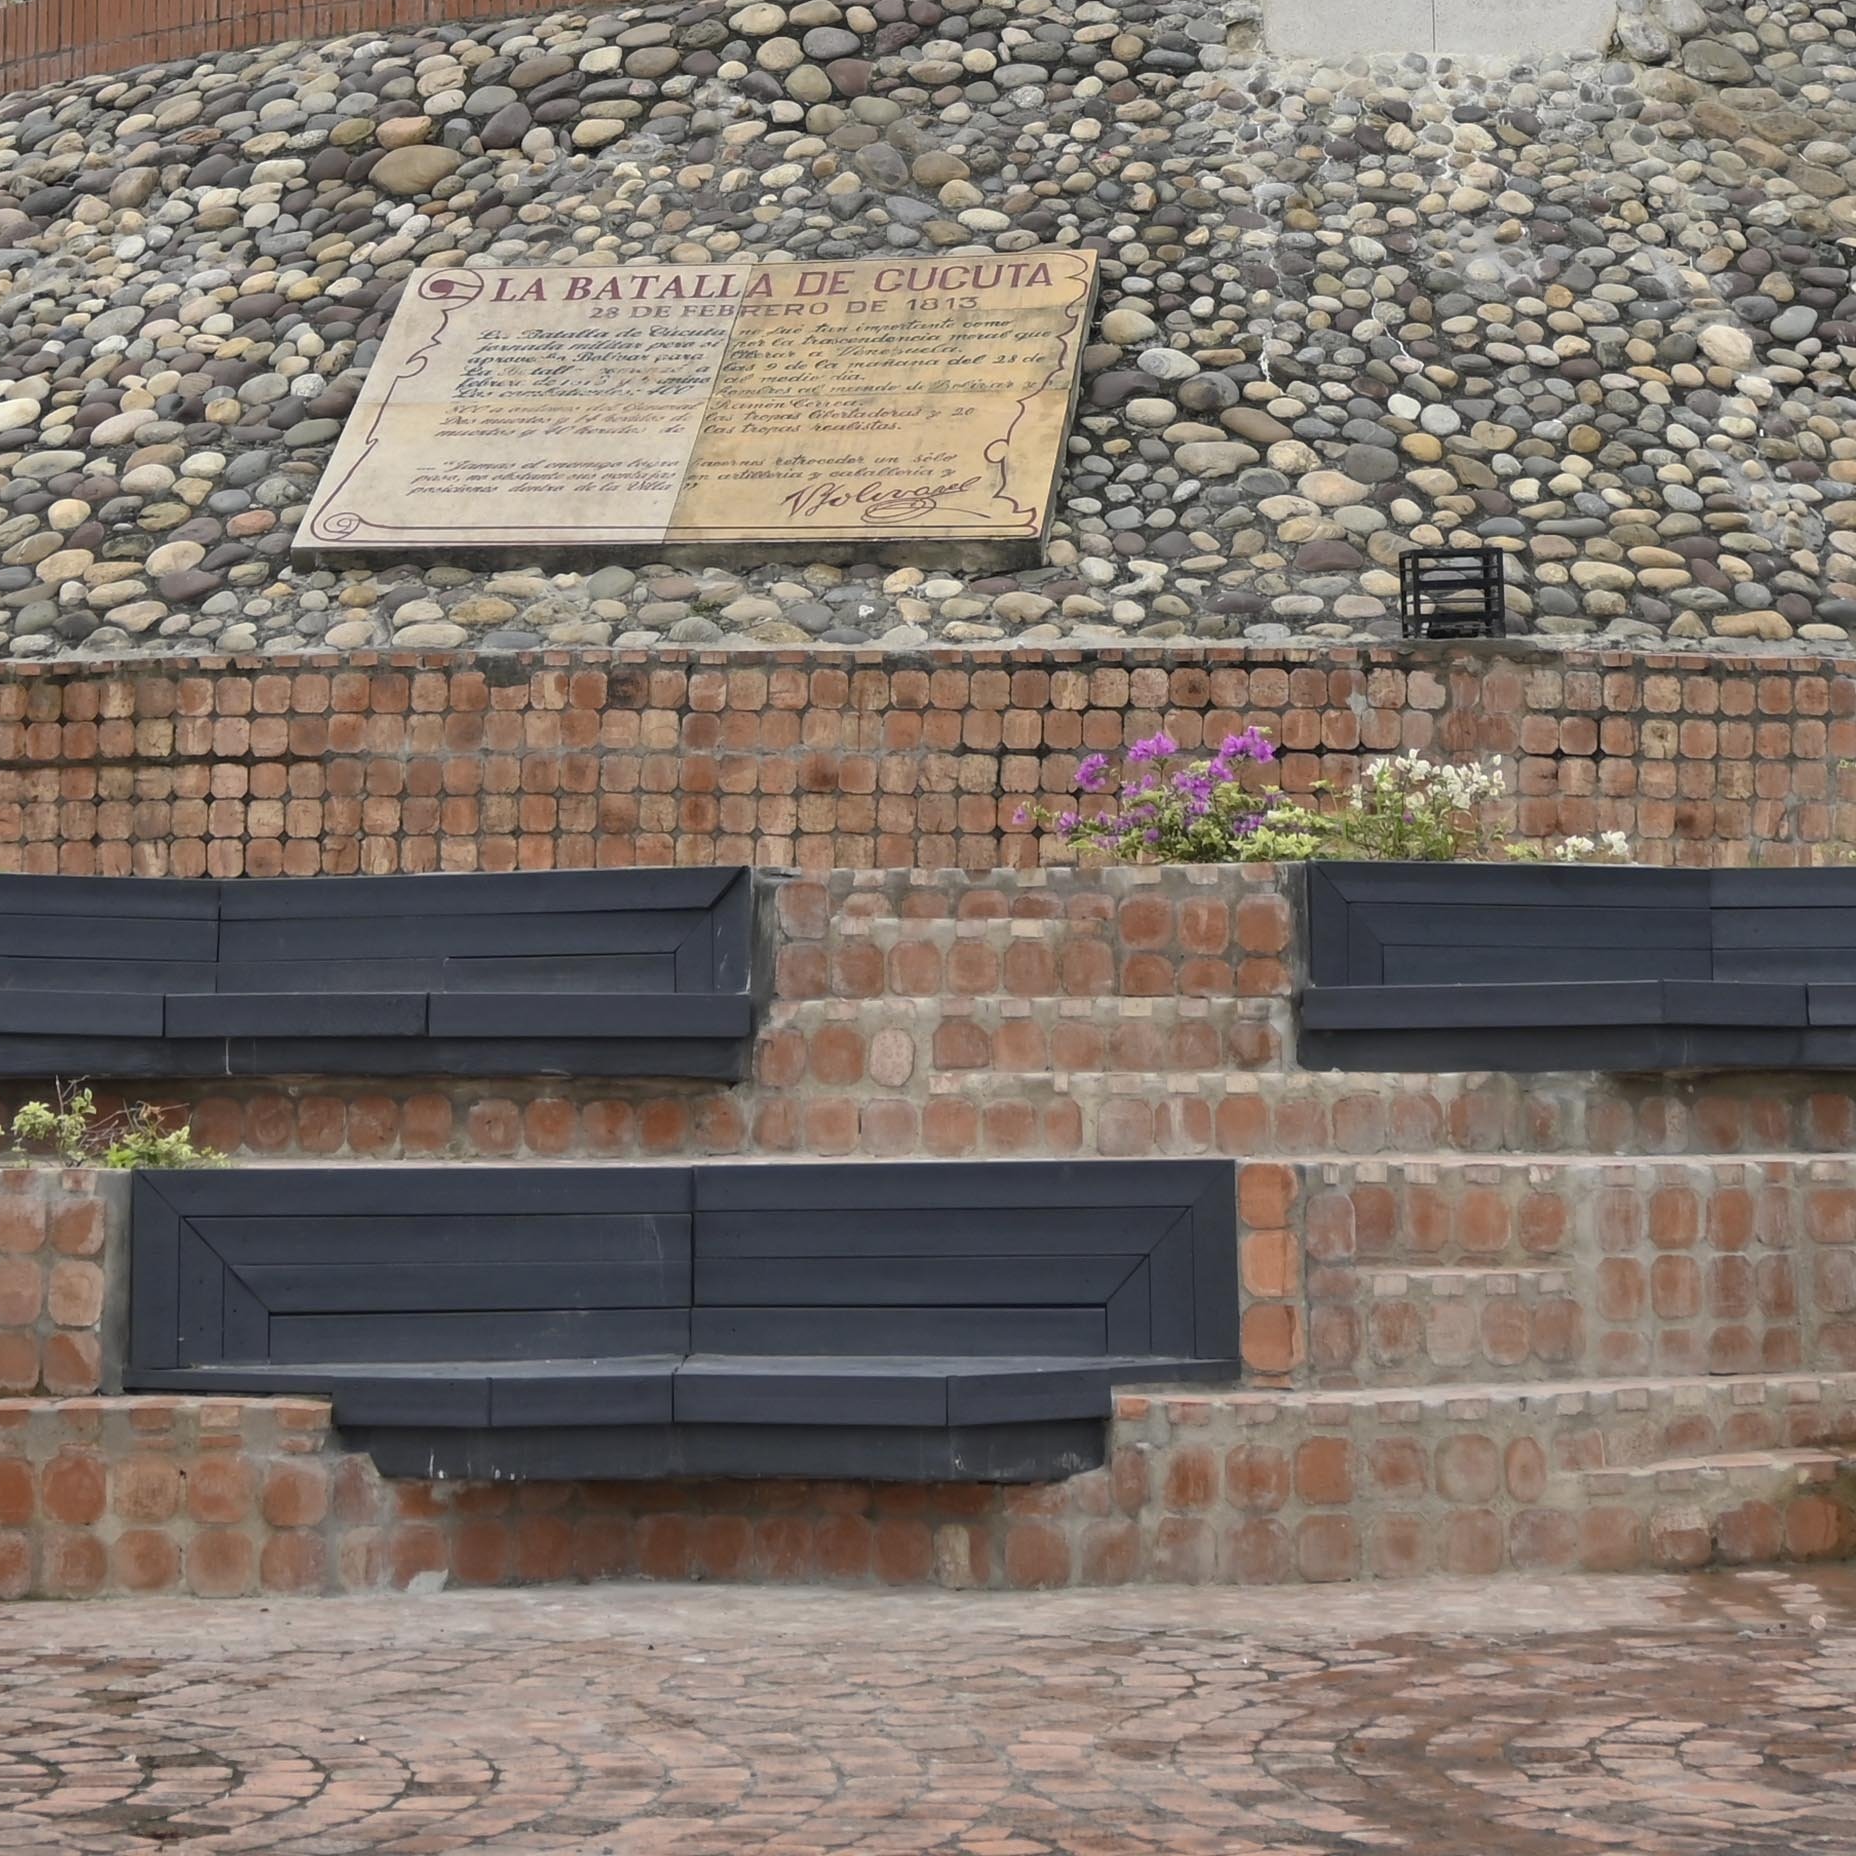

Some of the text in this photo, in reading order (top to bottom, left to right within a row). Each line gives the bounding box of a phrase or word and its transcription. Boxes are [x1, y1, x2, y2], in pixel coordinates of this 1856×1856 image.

[490, 262, 1054, 302] LA BATALLA DE CUCUTA
[589, 296, 979, 319] 28 DE FEBRERO DE 1813
[517, 328, 610, 339] Batalla
[614, 327, 642, 337] de
[815, 323, 848, 333] tan
[855, 318, 955, 334] importante
[962, 320, 1014, 328] como
[473, 341, 564, 355] jornada
[568, 340, 642, 350] militar
[644, 341, 696, 352] pero
[732, 339, 766, 351] por
[772, 337, 794, 346] la
[949, 330, 1014, 341] moral
[1014, 331, 1052, 342] que
[460, 365, 494, 376] La
[497, 365, 585, 376] Batall
[723, 361, 756, 372] las
[765, 363, 778, 371] 9
[784, 360, 808, 370] de
[815, 359, 840, 369] la
[847, 358, 941, 369] mañana
[947, 354, 987, 365] del
[992, 354, 1019, 364] 28
[1022, 352, 1047, 363] de
[653, 354, 705, 364] para
[532, 375, 559, 386] de
[724, 373, 755, 383] al
[760, 372, 819, 383] medio
[451, 387, 494, 398] Los
[715, 385, 793, 396] hombres
[797, 384, 826, 394] al
[831, 382, 901, 393] mando
[480, 416, 552, 425] muertos
[706, 412, 735, 422] las
[744, 410, 803, 423] tropas
[808, 407, 924, 419] libertadoras
[925, 409, 943, 420] y
[951, 406, 977, 417] 20
[434, 427, 517, 437] muertos
[658, 423, 686, 434] de
[703, 424, 737, 434] las
[741, 422, 802, 435] tropas
[520, 459, 548, 470] el
[544, 461, 624, 471] enemigo
[775, 454, 865, 467] retroceder
[874, 456, 899, 464] un
[465, 473, 489, 481] no
[507, 482, 565, 493] dentro
[573, 481, 598, 492] de
[599, 481, 620, 492] la
